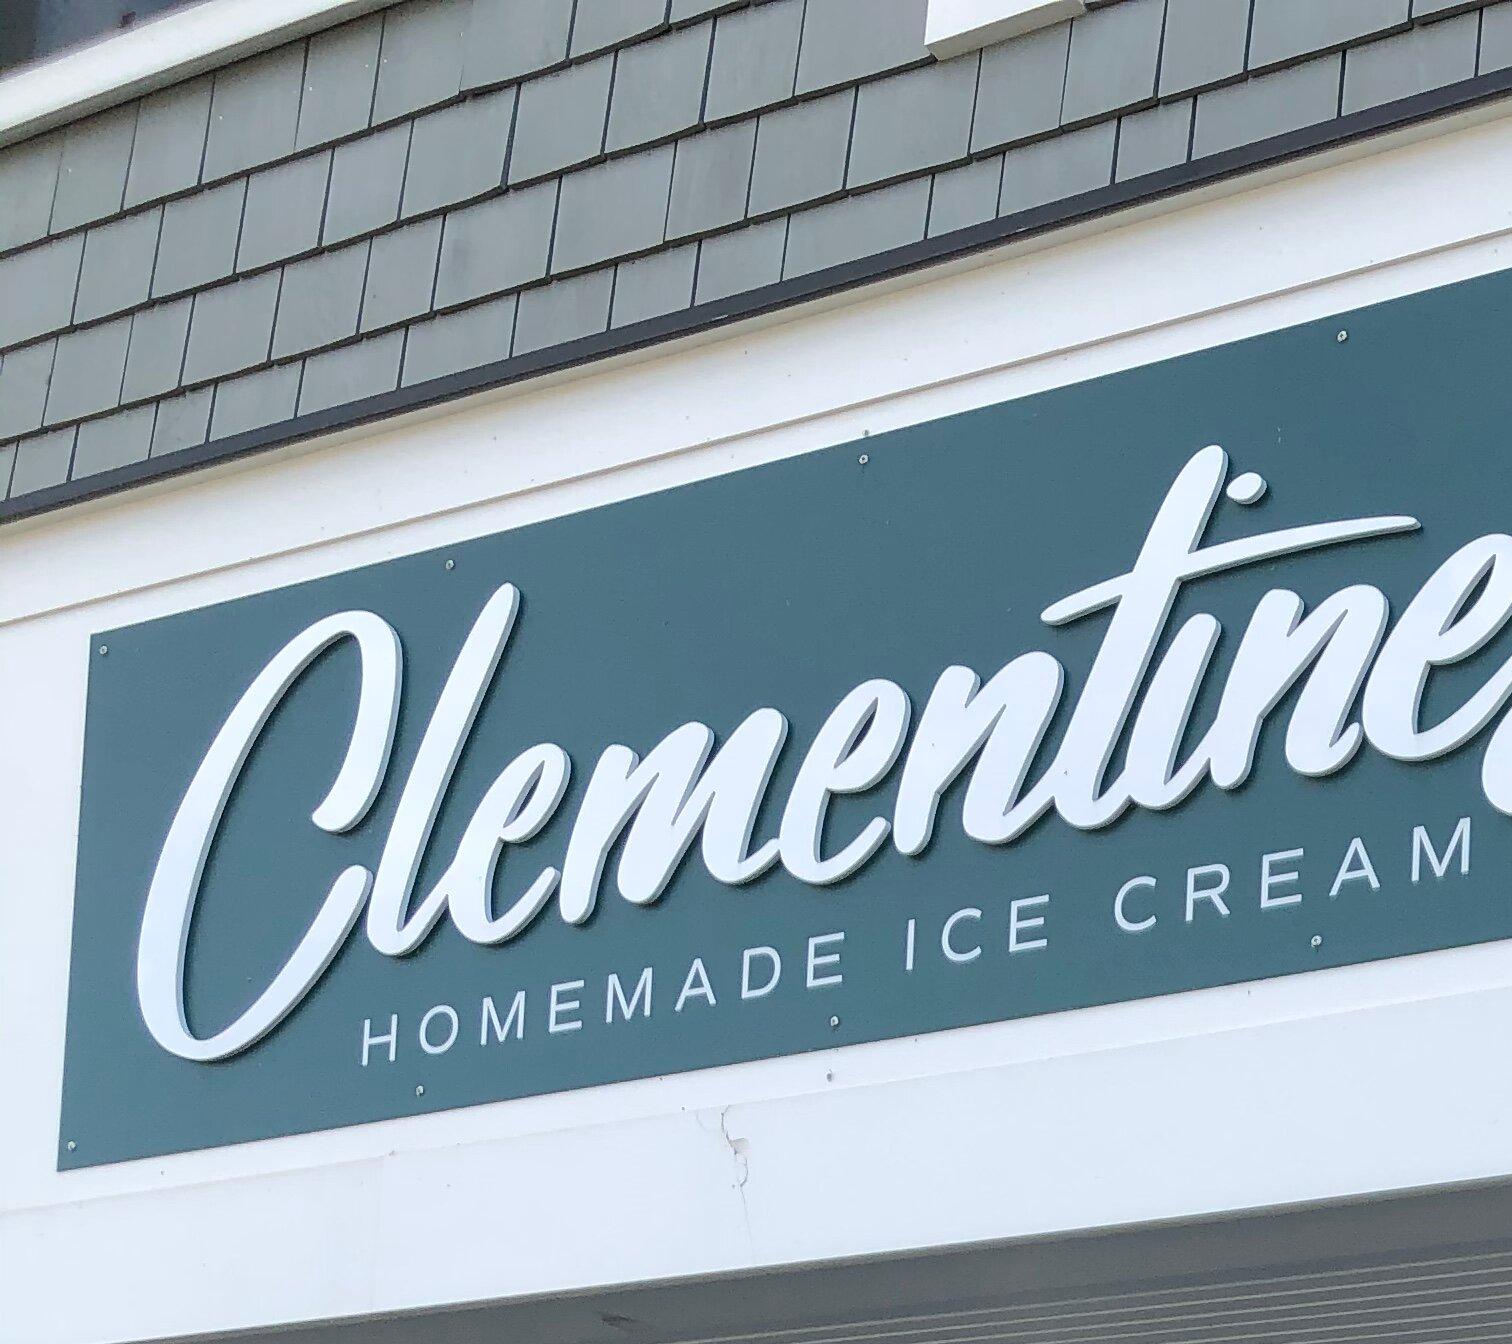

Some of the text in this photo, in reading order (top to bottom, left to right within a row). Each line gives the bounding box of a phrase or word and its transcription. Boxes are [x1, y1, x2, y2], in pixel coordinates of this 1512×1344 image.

[360, 816, 1477, 1068] HOMEMADE ICE CREAM
